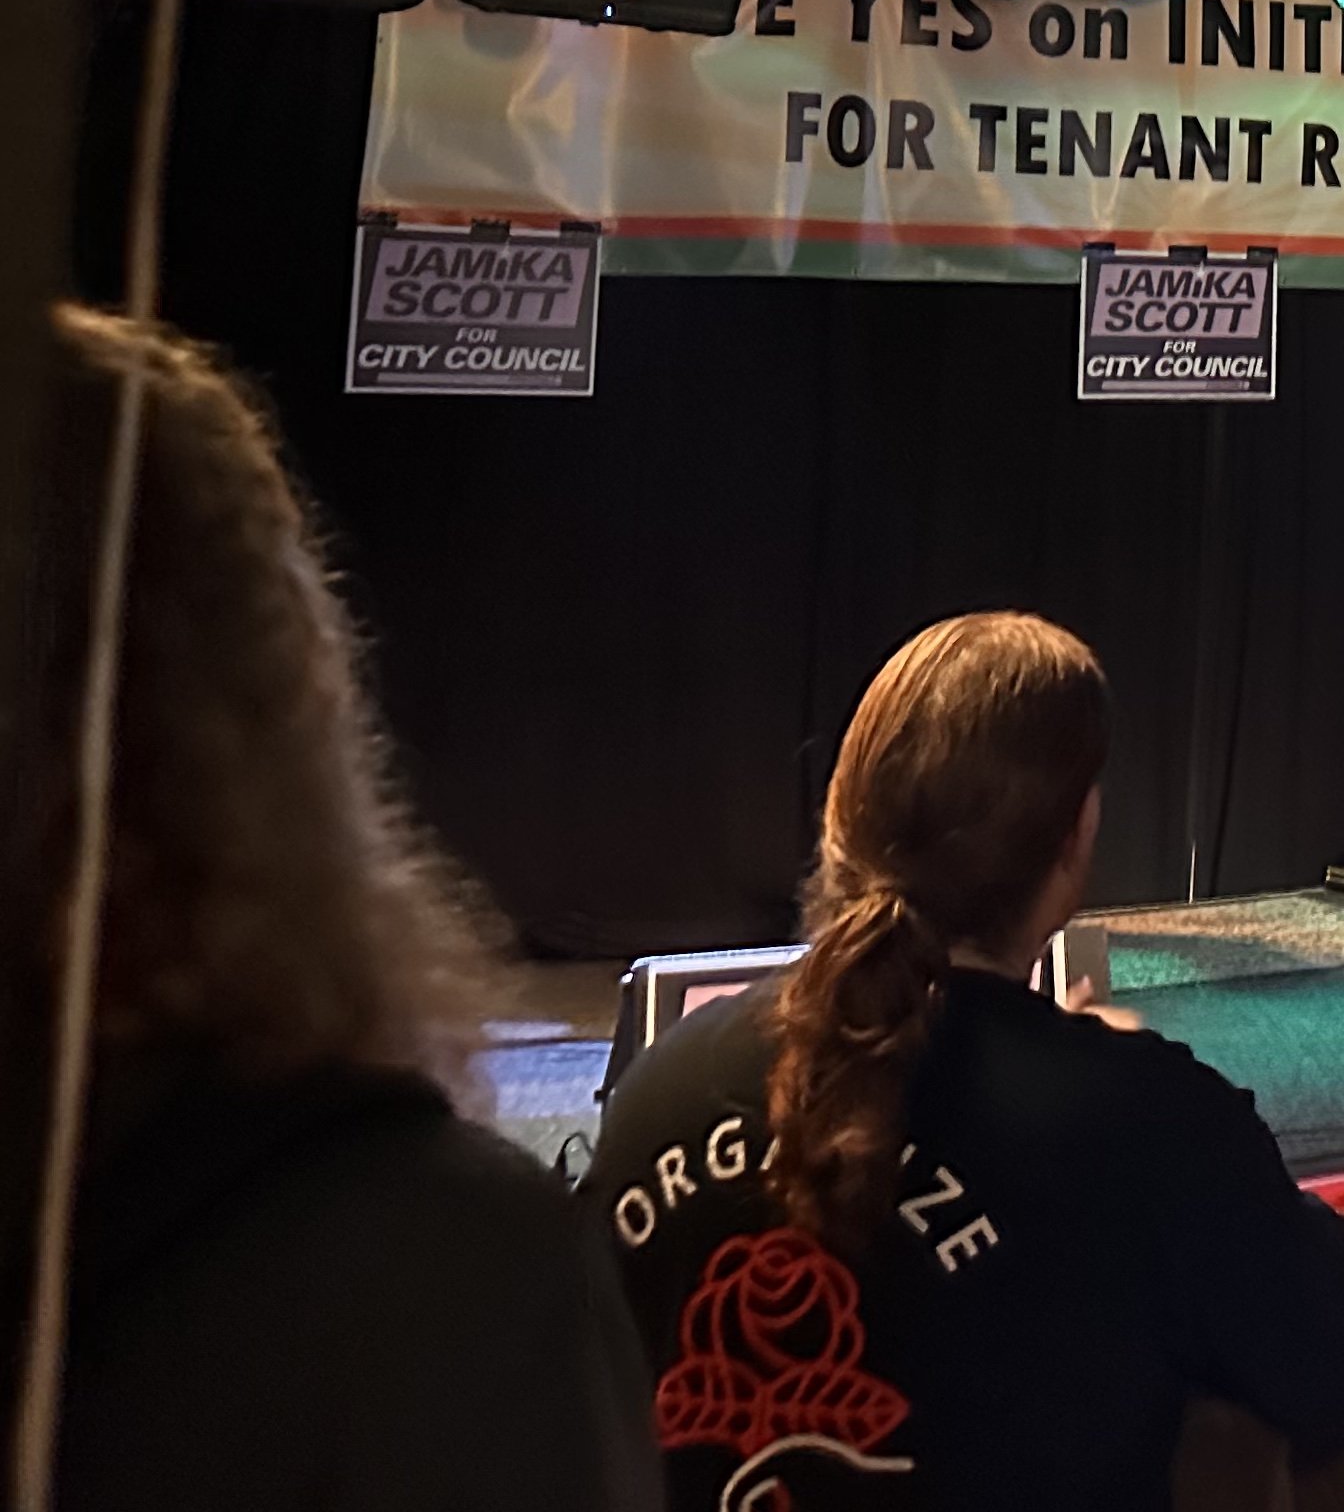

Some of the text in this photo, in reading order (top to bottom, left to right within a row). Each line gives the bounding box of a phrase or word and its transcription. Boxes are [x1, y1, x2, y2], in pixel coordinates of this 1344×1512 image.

[1029, 5, 1128, 61] on
[785, 92, 935, 171] FOR
[970, 104, 1273, 183] TENANT
[382, 279, 570, 322] SCOTT
[1104, 300, 1252, 333] SCOTT
[455, 327, 498, 343] FOR
[1163, 340, 1196, 354] FOR
[358, 344, 586, 372] CITY COUNCIL
[1086, 355, 1268, 379] CITY COUNCIL
[614, 1116, 999, 1274] ORGZE
